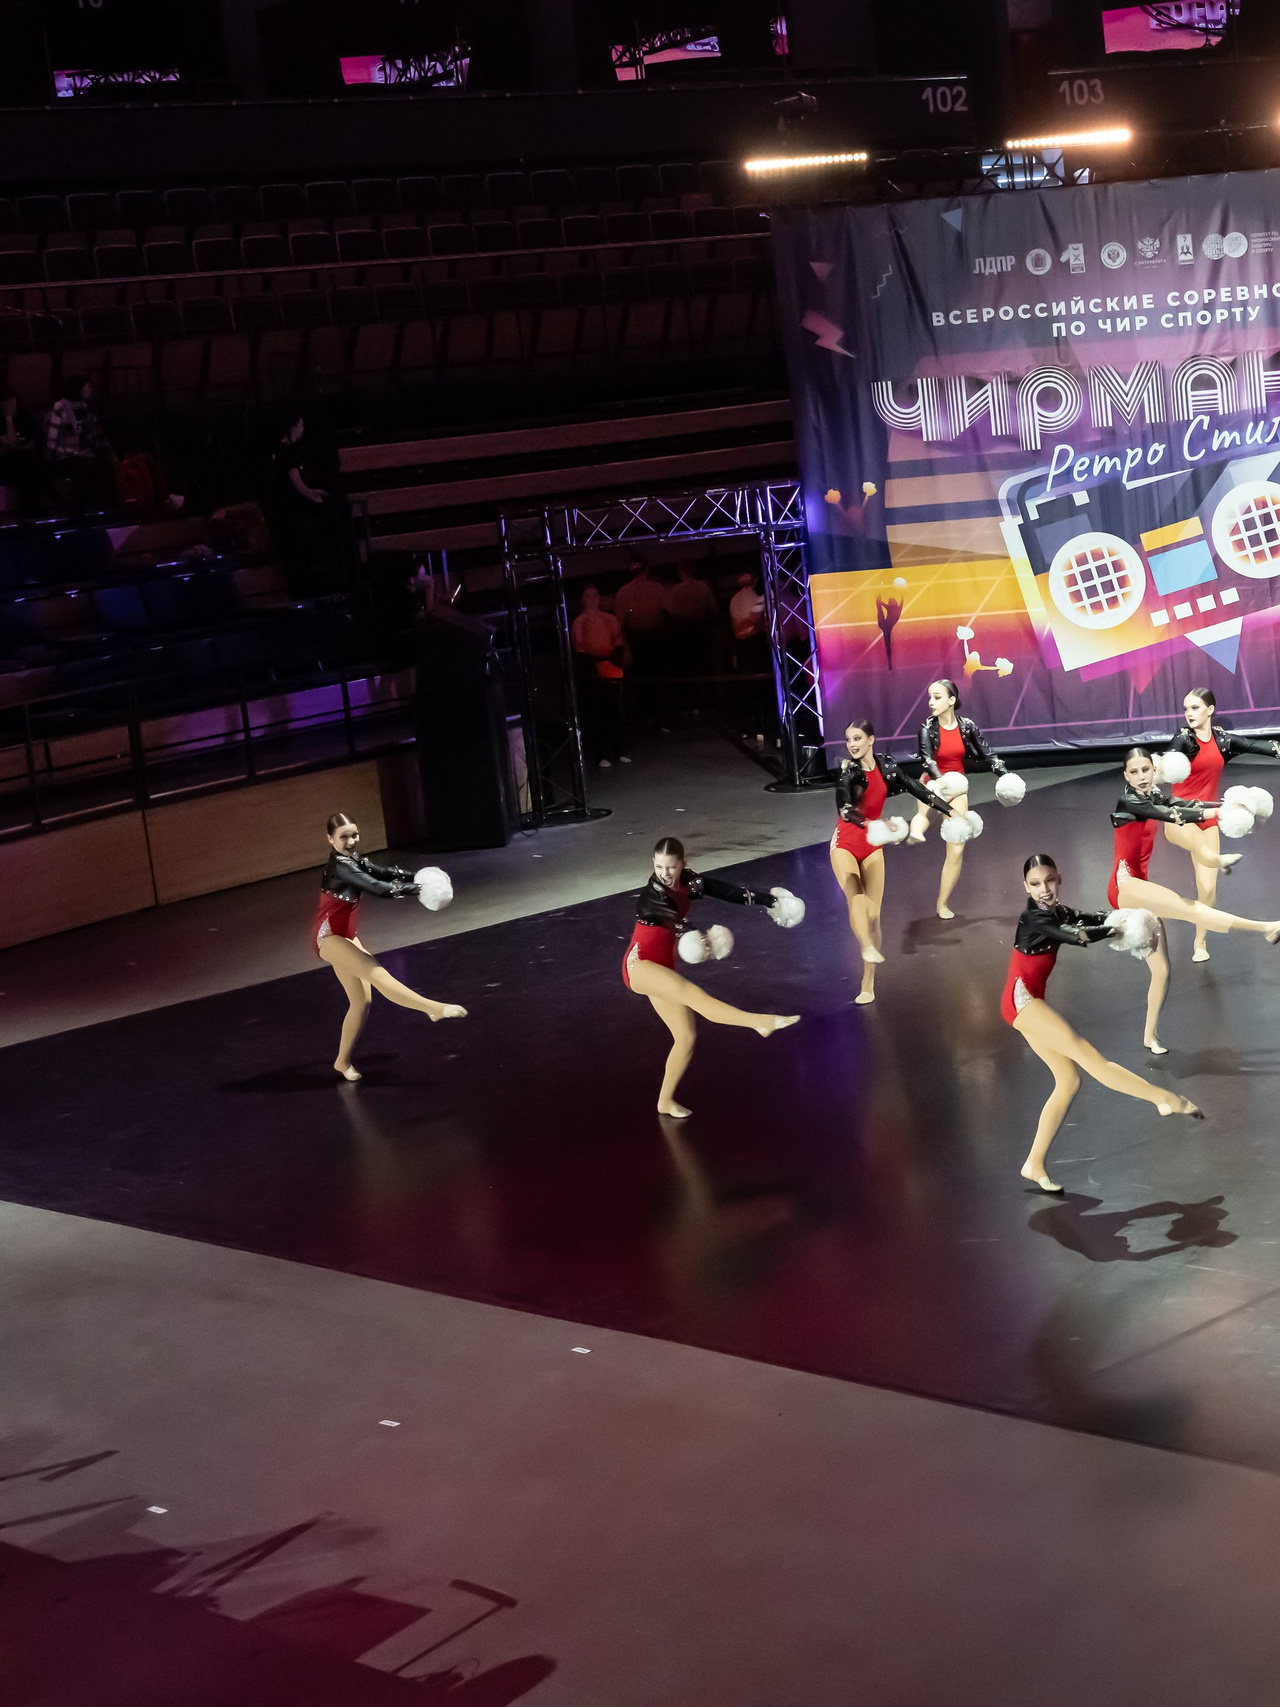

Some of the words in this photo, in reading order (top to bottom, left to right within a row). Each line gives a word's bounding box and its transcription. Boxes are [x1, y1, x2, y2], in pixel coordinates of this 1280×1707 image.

[922, 85, 968, 113] 102
[1058, 78, 1105, 106] 103
[973, 255, 1016, 276] ЛДПР
[931, 293, 1155, 327] ВСЕРОССИЙСКИЕ
[1052, 320, 1086, 338] ПО
[1098, 315, 1148, 333] ЧИР
[1160, 305, 1260, 328] СПОРТУ
[1046, 442, 1166, 492] Ретро
